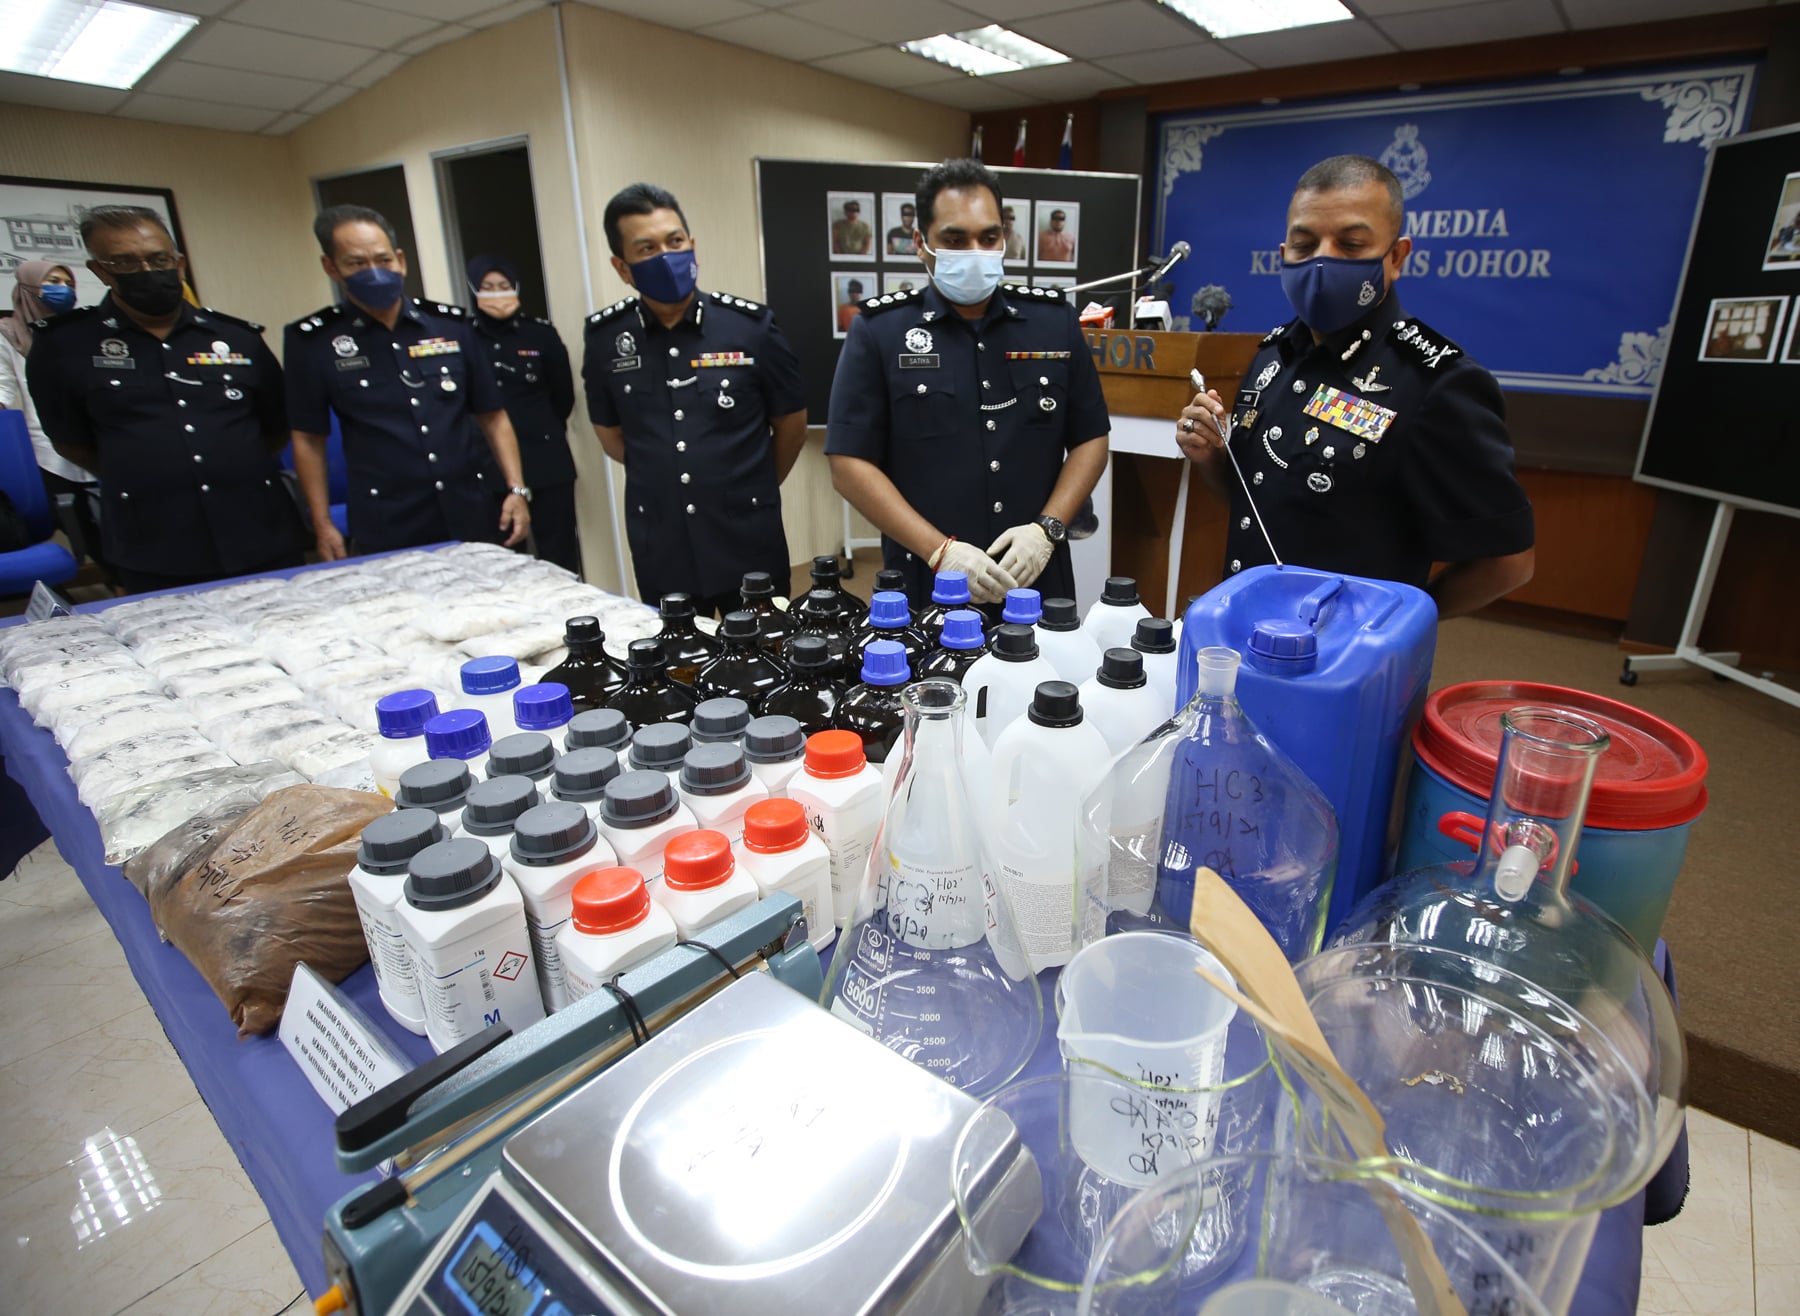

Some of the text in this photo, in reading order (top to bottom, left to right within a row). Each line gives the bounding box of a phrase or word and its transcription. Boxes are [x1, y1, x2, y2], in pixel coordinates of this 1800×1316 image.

[1403, 209, 1509, 238] MEDIA
[1440, 249, 1552, 277] JOHOR
[913, 952, 931, 961] 4000
[846, 980, 875, 1011] 5000
[916, 986, 936, 995] 3500
[306, 1008, 327, 1036] ISKANDAR
[316, 998, 337, 1025] ISKANDAR
[336, 1022, 351, 1041] PUTERI
[919, 1013, 941, 1022] 3000
[923, 1036, 946, 1046] 2500
[927, 1057, 951, 1067] 2000
[346, 1078, 359, 1096] 1952
